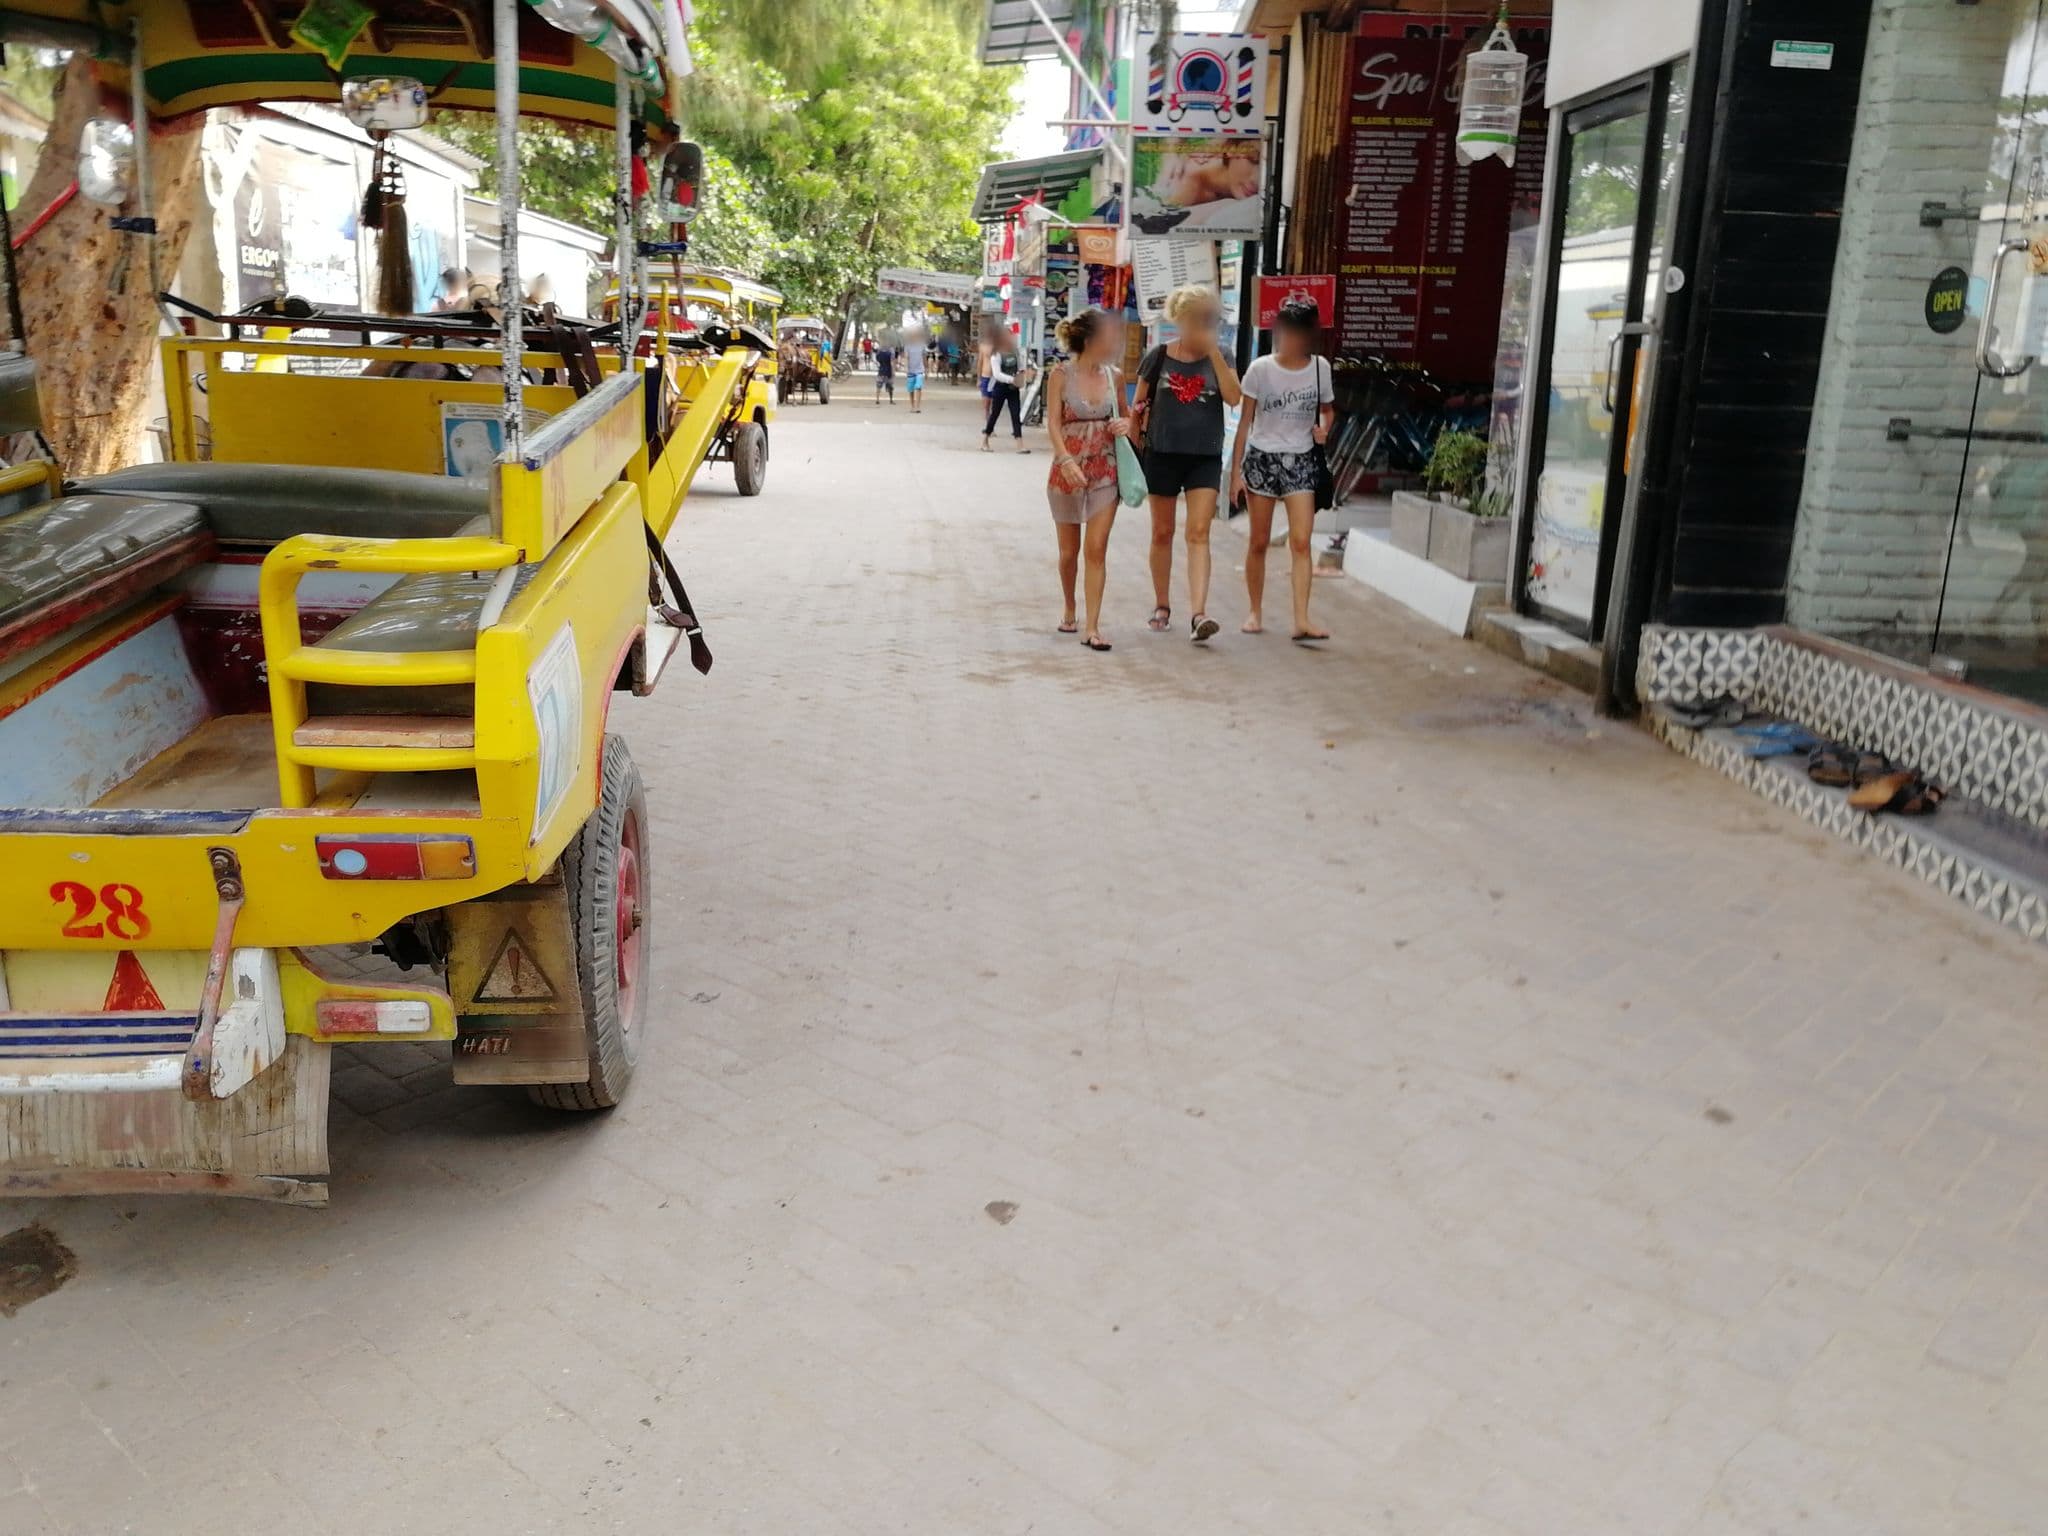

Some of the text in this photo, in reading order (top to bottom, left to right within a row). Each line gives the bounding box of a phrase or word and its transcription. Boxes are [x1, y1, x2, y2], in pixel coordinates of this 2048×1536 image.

[1353, 52, 1430, 110] Spa
[1394, 117, 1433, 126] MASSAGE
[1341, 265, 1373, 273] BEAUTY
[1419, 267, 1456, 275] PACKAGE
[1933, 289, 1963, 312] OPEN
[49, 880, 151, 940] 28
[462, 1038, 511, 1054] HATI
